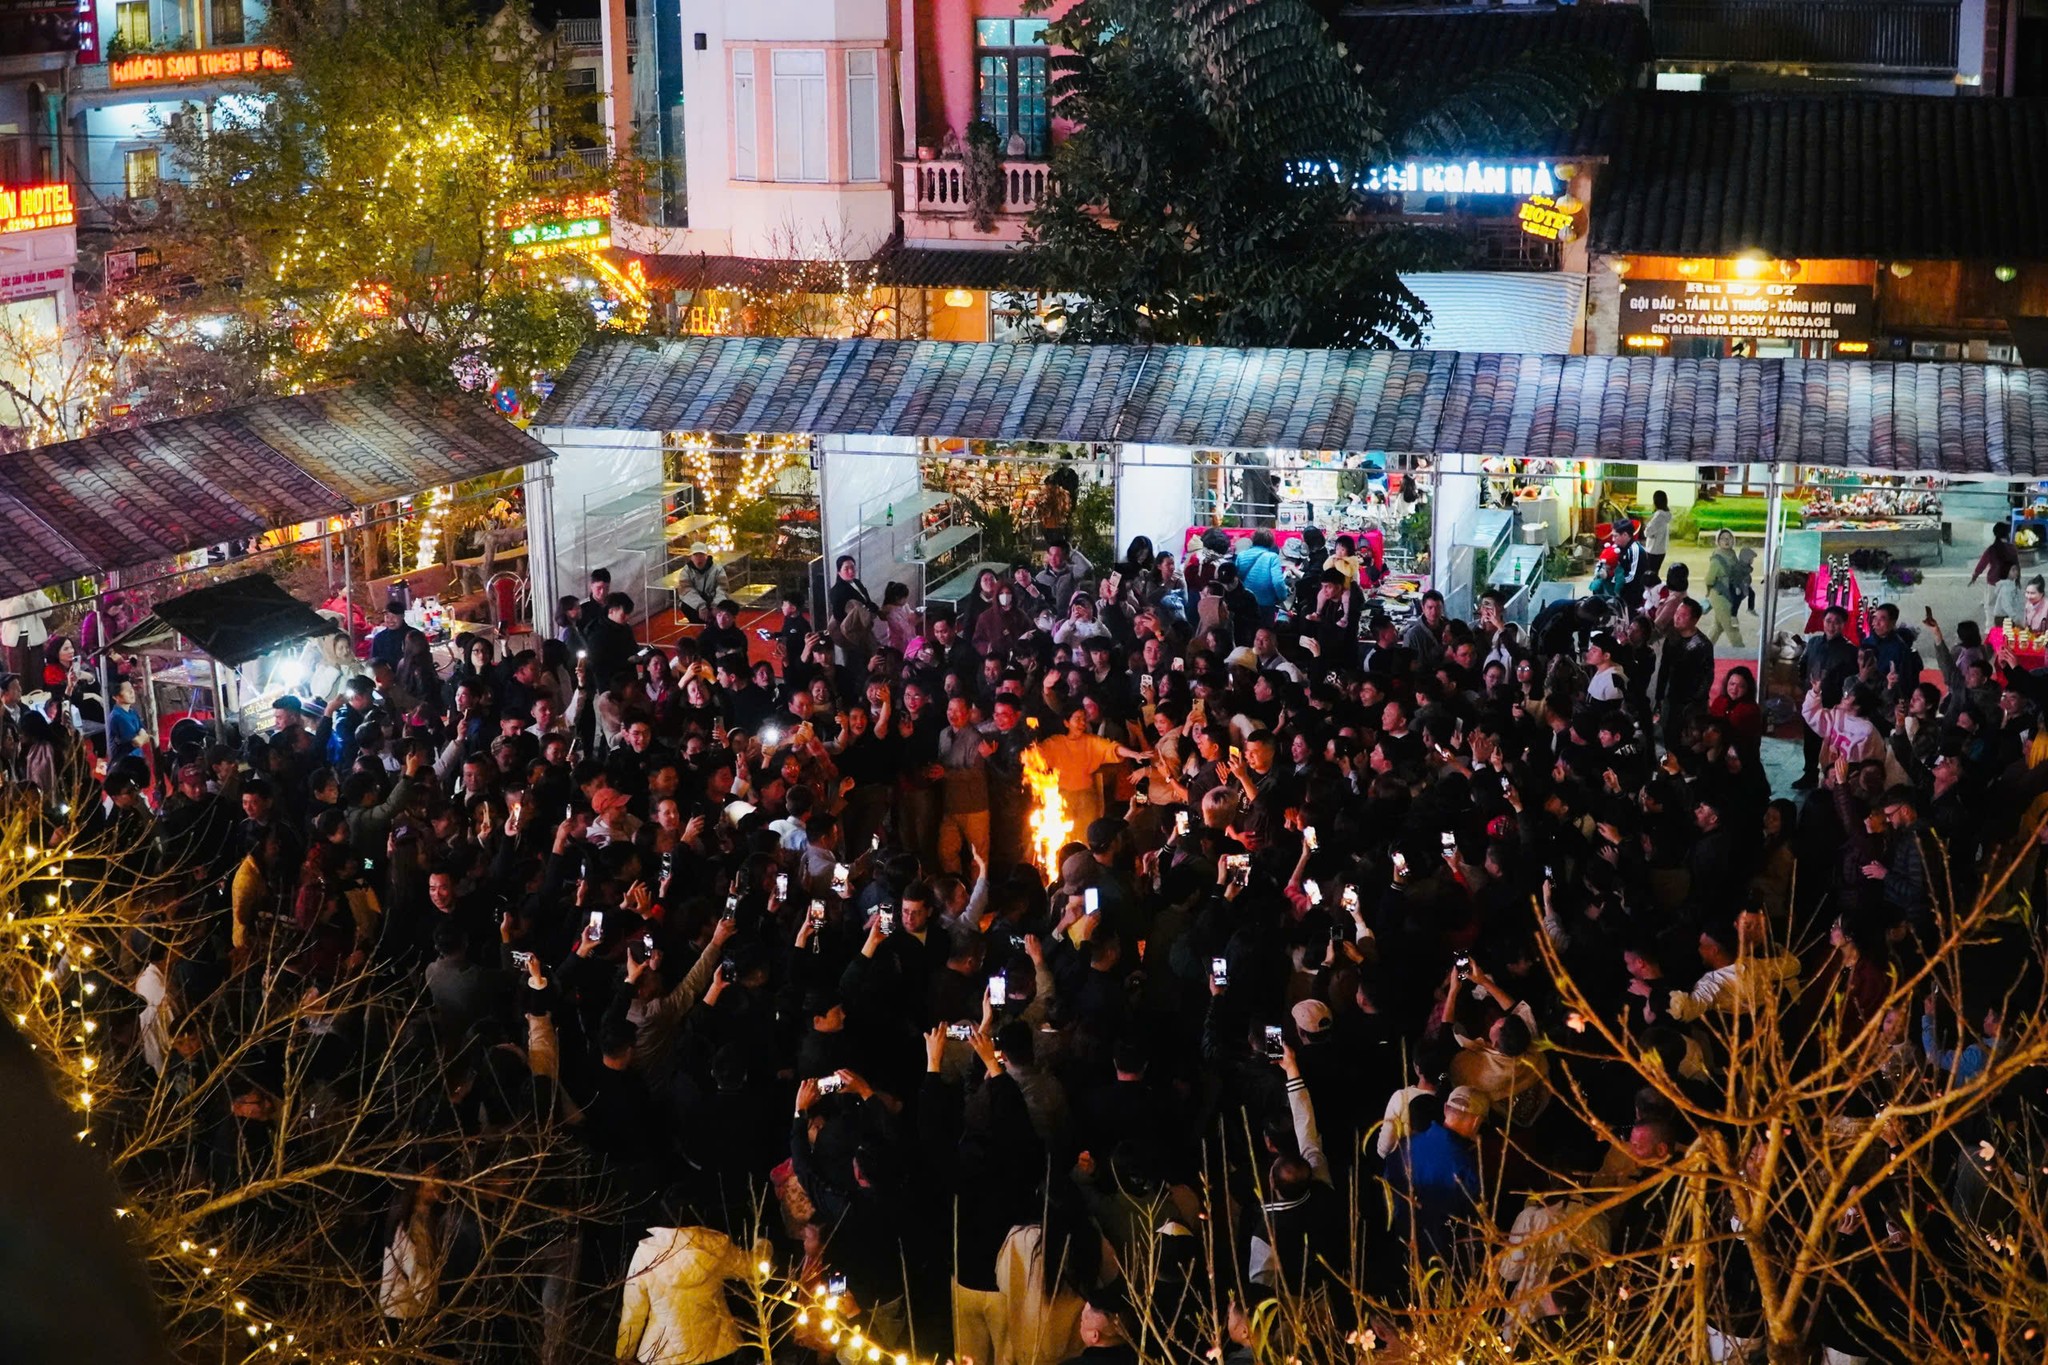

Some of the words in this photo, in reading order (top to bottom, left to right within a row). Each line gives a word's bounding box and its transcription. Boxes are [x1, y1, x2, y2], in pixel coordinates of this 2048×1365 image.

[21, 184, 74, 216] HOTEL
[1766, 283, 1798, 296] 07
[1630, 296, 1649, 312] GỘI
[1777, 298, 1809, 314] XÔNG
[1834, 302, 1856, 315] OMI
[1659, 313, 1695, 324] FOOT
[1698, 313, 1727, 325] AND
[1730, 314, 1767, 327] BODY
[1768, 315, 1831, 328] MASSAGE
[1838, 342, 1868, 352] FOOT
